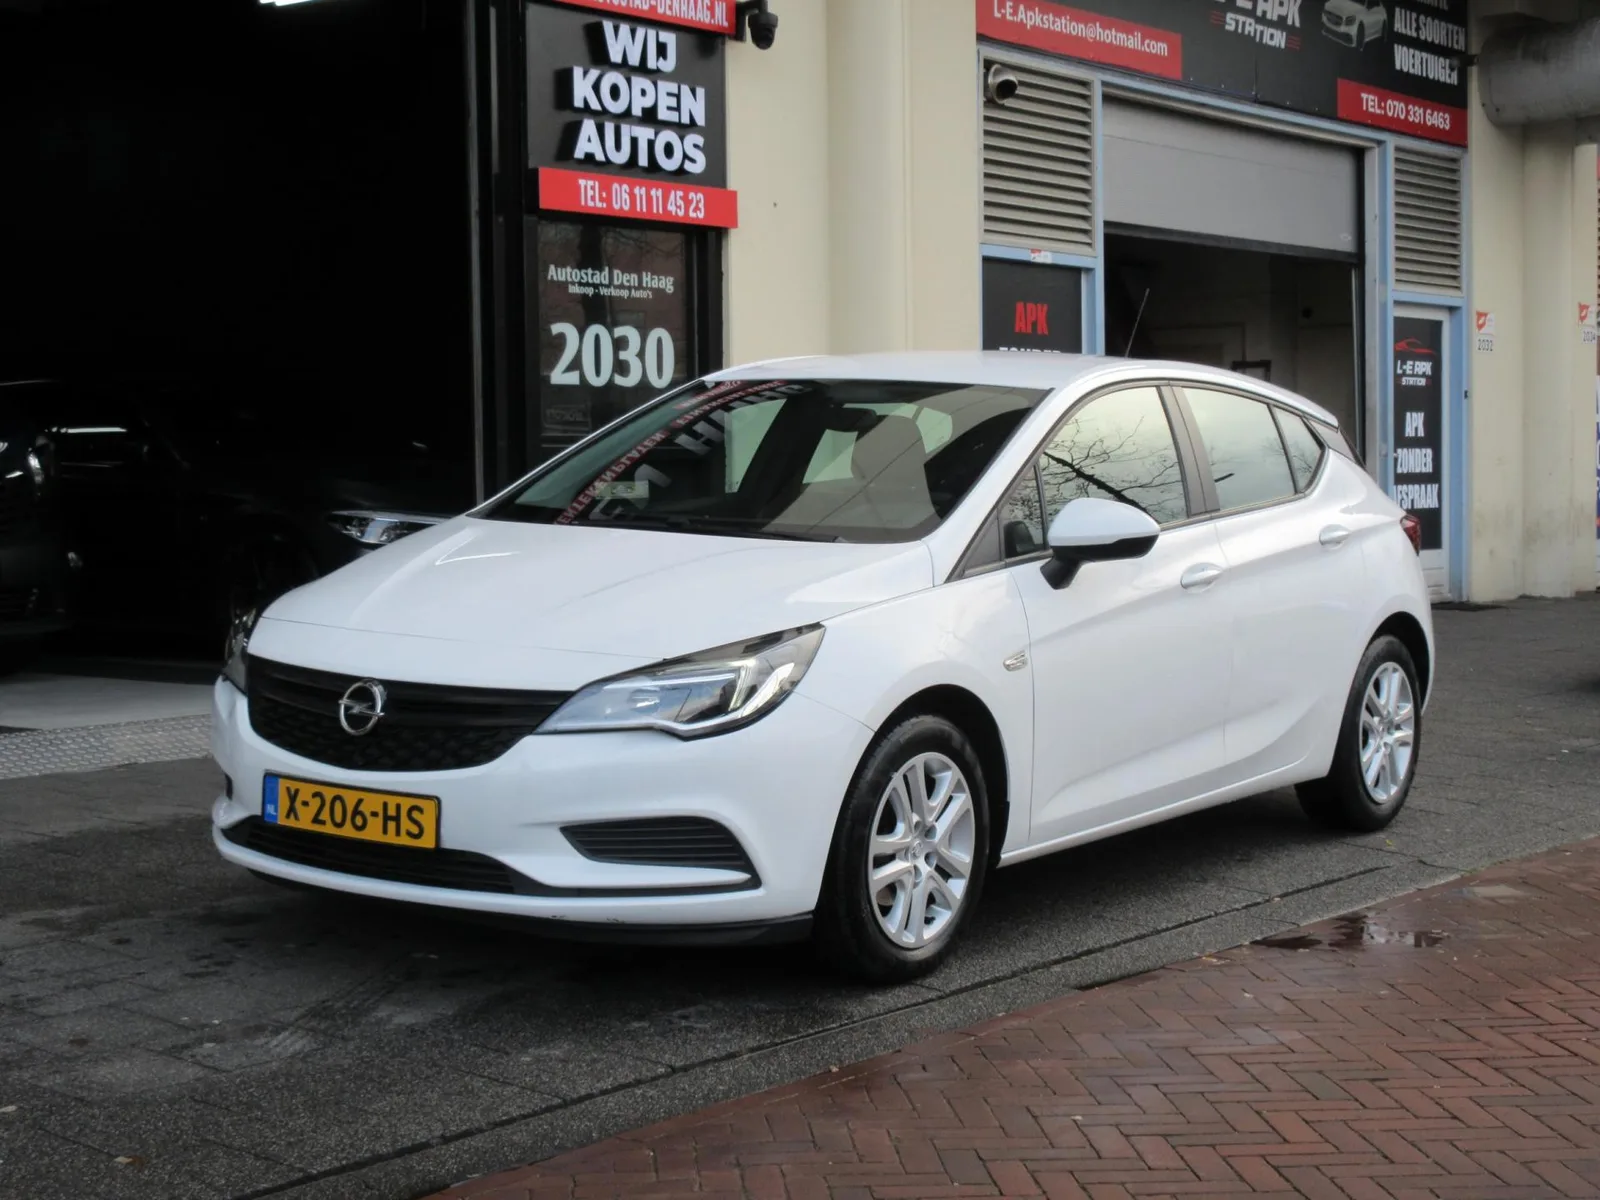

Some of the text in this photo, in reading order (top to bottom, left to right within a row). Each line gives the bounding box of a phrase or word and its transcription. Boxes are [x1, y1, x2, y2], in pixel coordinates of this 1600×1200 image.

[602, 20, 676, 73] WIJ
[993, 0, 1168, 56] L-E.Apkstation@hotmail.com
[1225, 12, 1286, 49] STATION
[1394, 8, 1465, 52] ALLE SOORTEN
[572, 65, 706, 127] KOPEN
[1361, 92, 1450, 131] TEL: 070 331 6463
[573, 118, 707, 174] AUTOS
[578, 179, 705, 218] TEL: 06 11 11 45 23
[547, 264, 674, 294] Autostad Den Haag
[568, 283, 594, 297] Inkoop
[600, 286, 629, 299] Verkoop
[631, 288, 653, 299] Auto's
[1014, 301, 1049, 335] APK
[550, 322, 675, 389] 2030
[1397, 360, 1432, 375] L-E APK
[1405, 412, 1425, 437] APK
[1397, 448, 1433, 474] ZONDER
[266, 803, 277, 815] NL
[285, 786, 425, 840] X-206-HS
